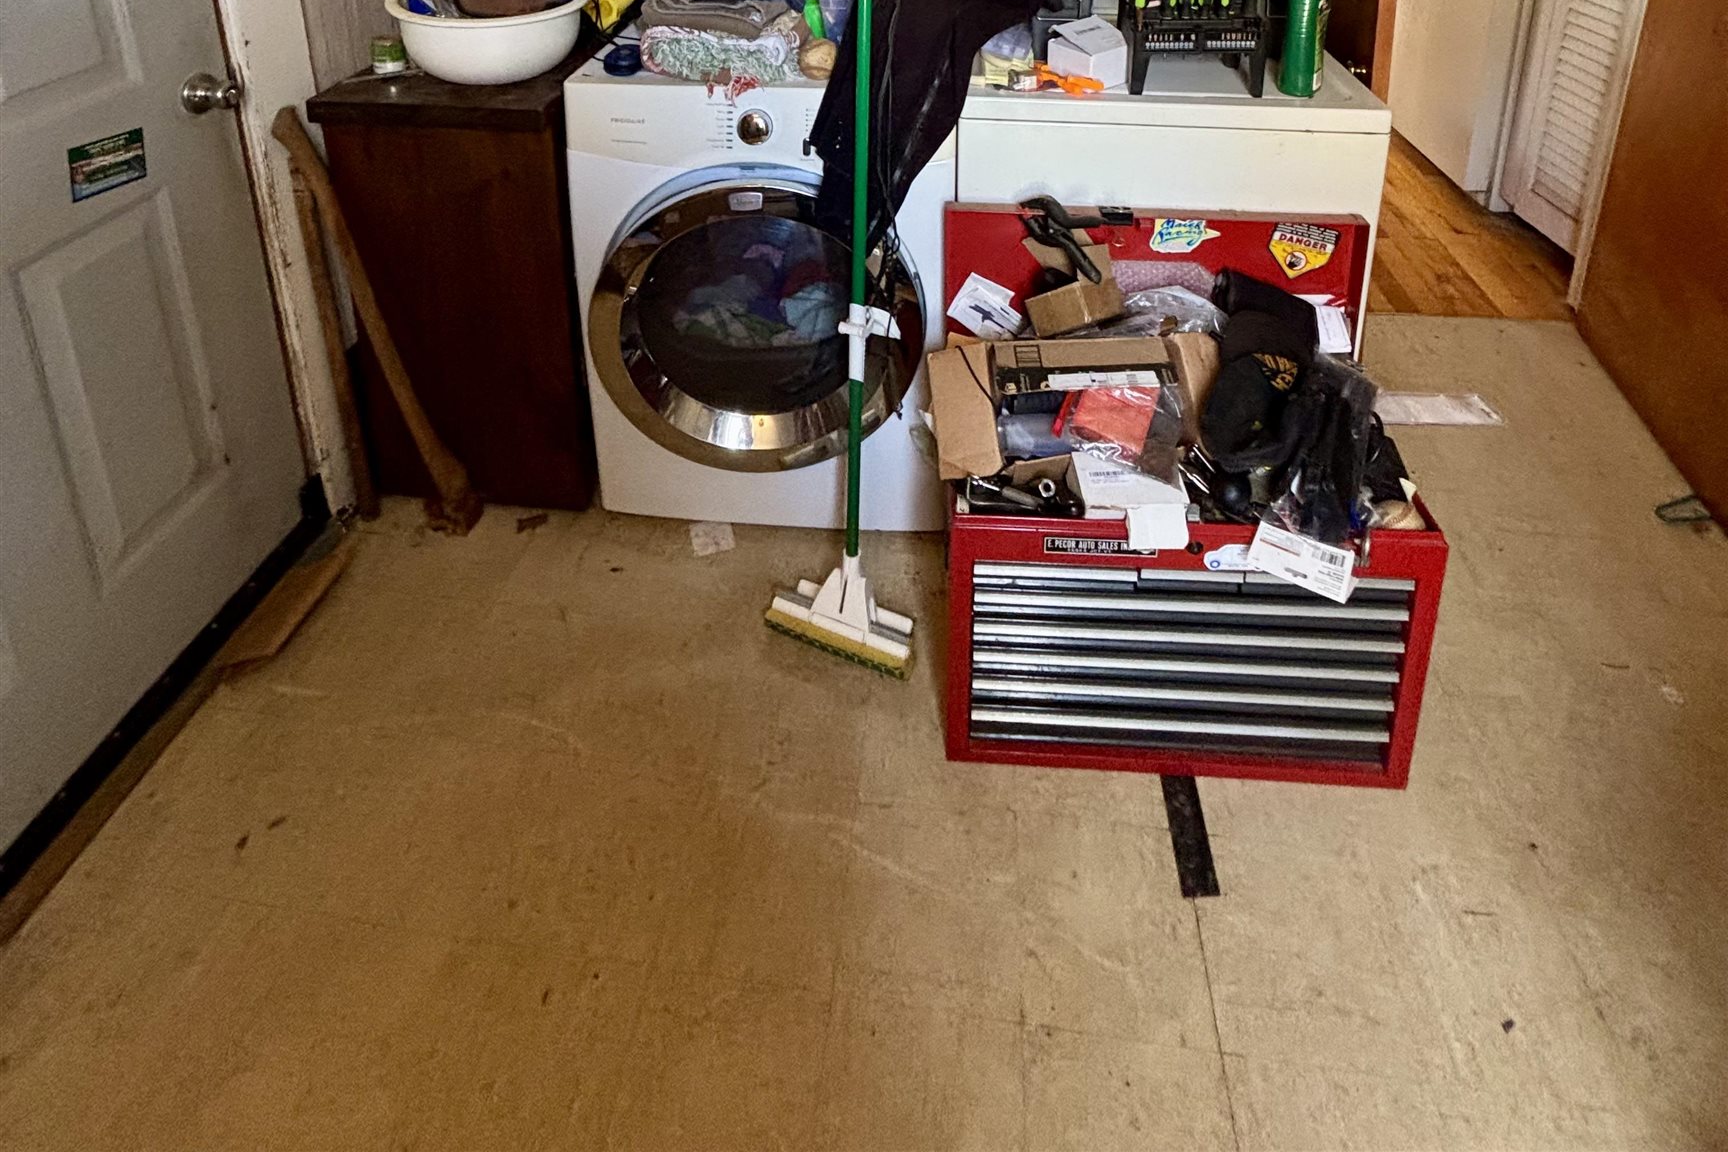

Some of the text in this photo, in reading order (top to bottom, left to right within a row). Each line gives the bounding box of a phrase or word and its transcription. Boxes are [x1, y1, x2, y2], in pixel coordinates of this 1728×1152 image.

[1278, 232, 1329, 251] DANGER
[1054, 539, 1076, 549] PECOR
[1078, 540, 1095, 549] AUTO
[1097, 541, 1118, 551] SALES
